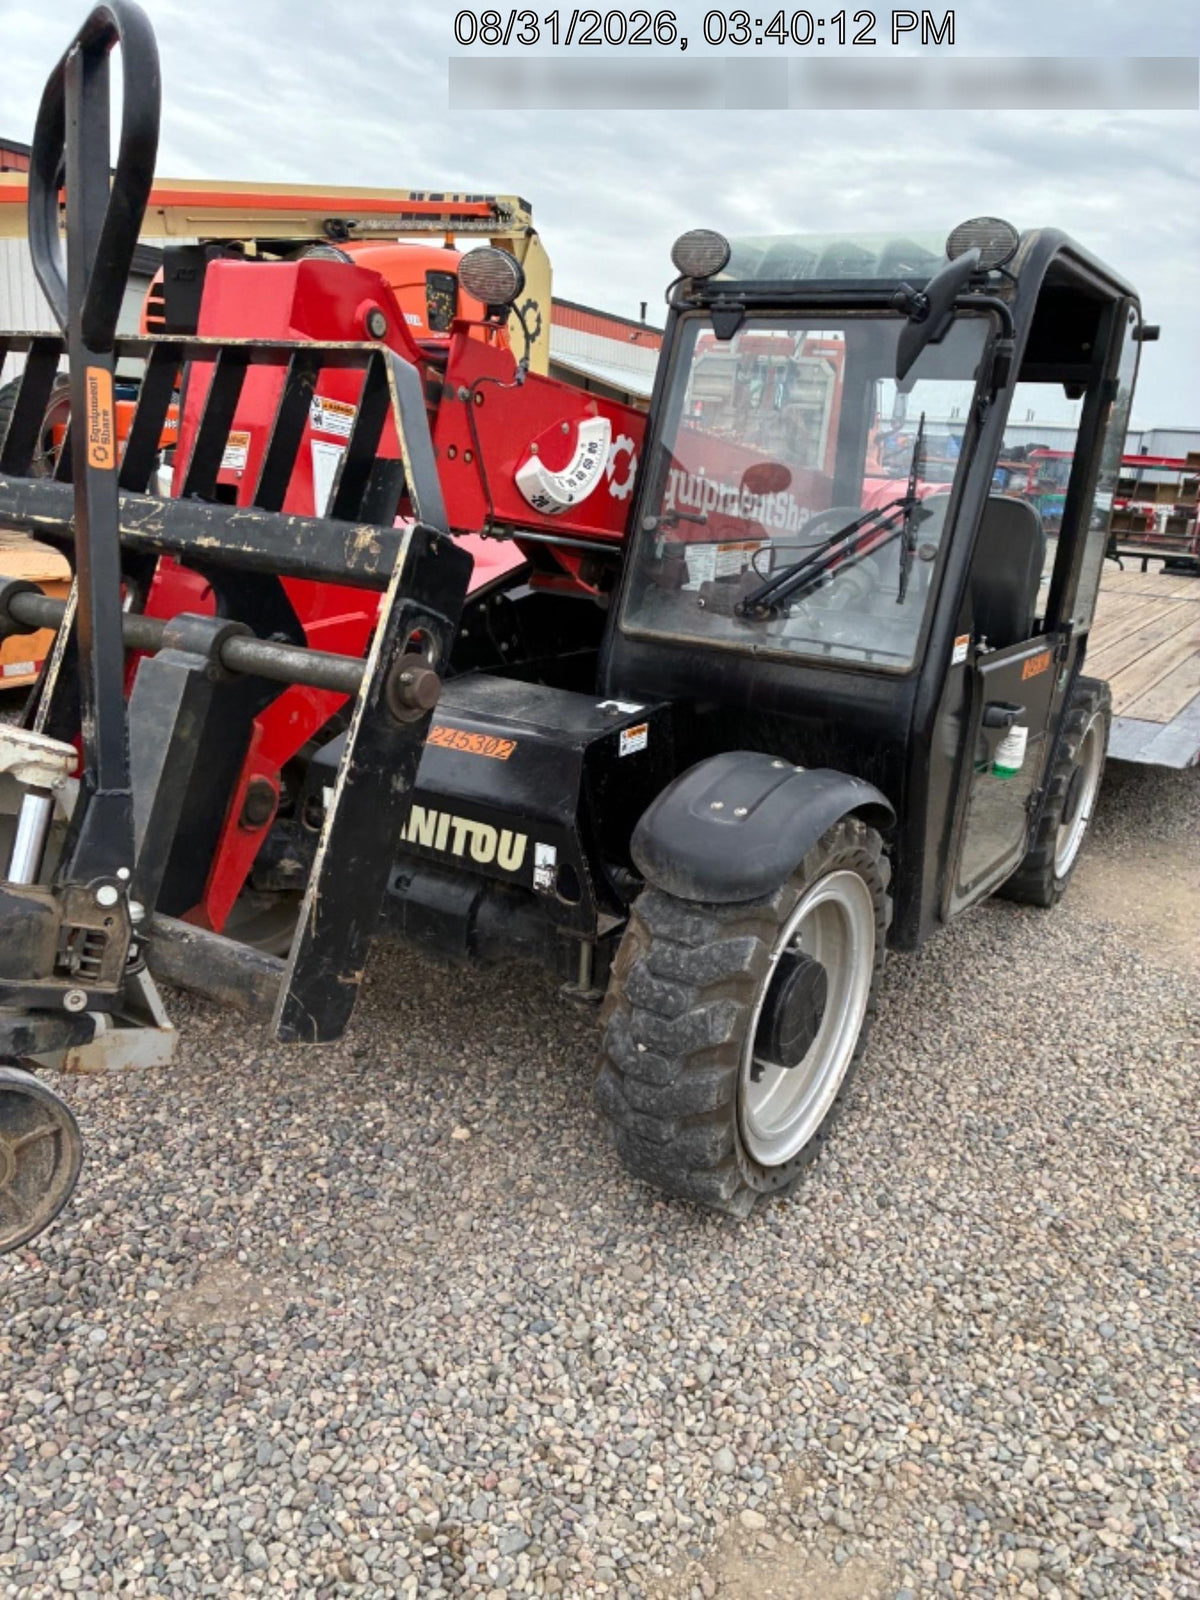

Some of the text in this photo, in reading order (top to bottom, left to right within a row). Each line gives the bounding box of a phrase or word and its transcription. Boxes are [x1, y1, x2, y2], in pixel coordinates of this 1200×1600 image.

[89, 376, 101, 444] Equipment
[101, 408, 112, 445] Share
[664, 466, 820, 532] quipmentSha
[428, 727, 514, 759] 245302
[401, 804, 529, 872] NITOU
